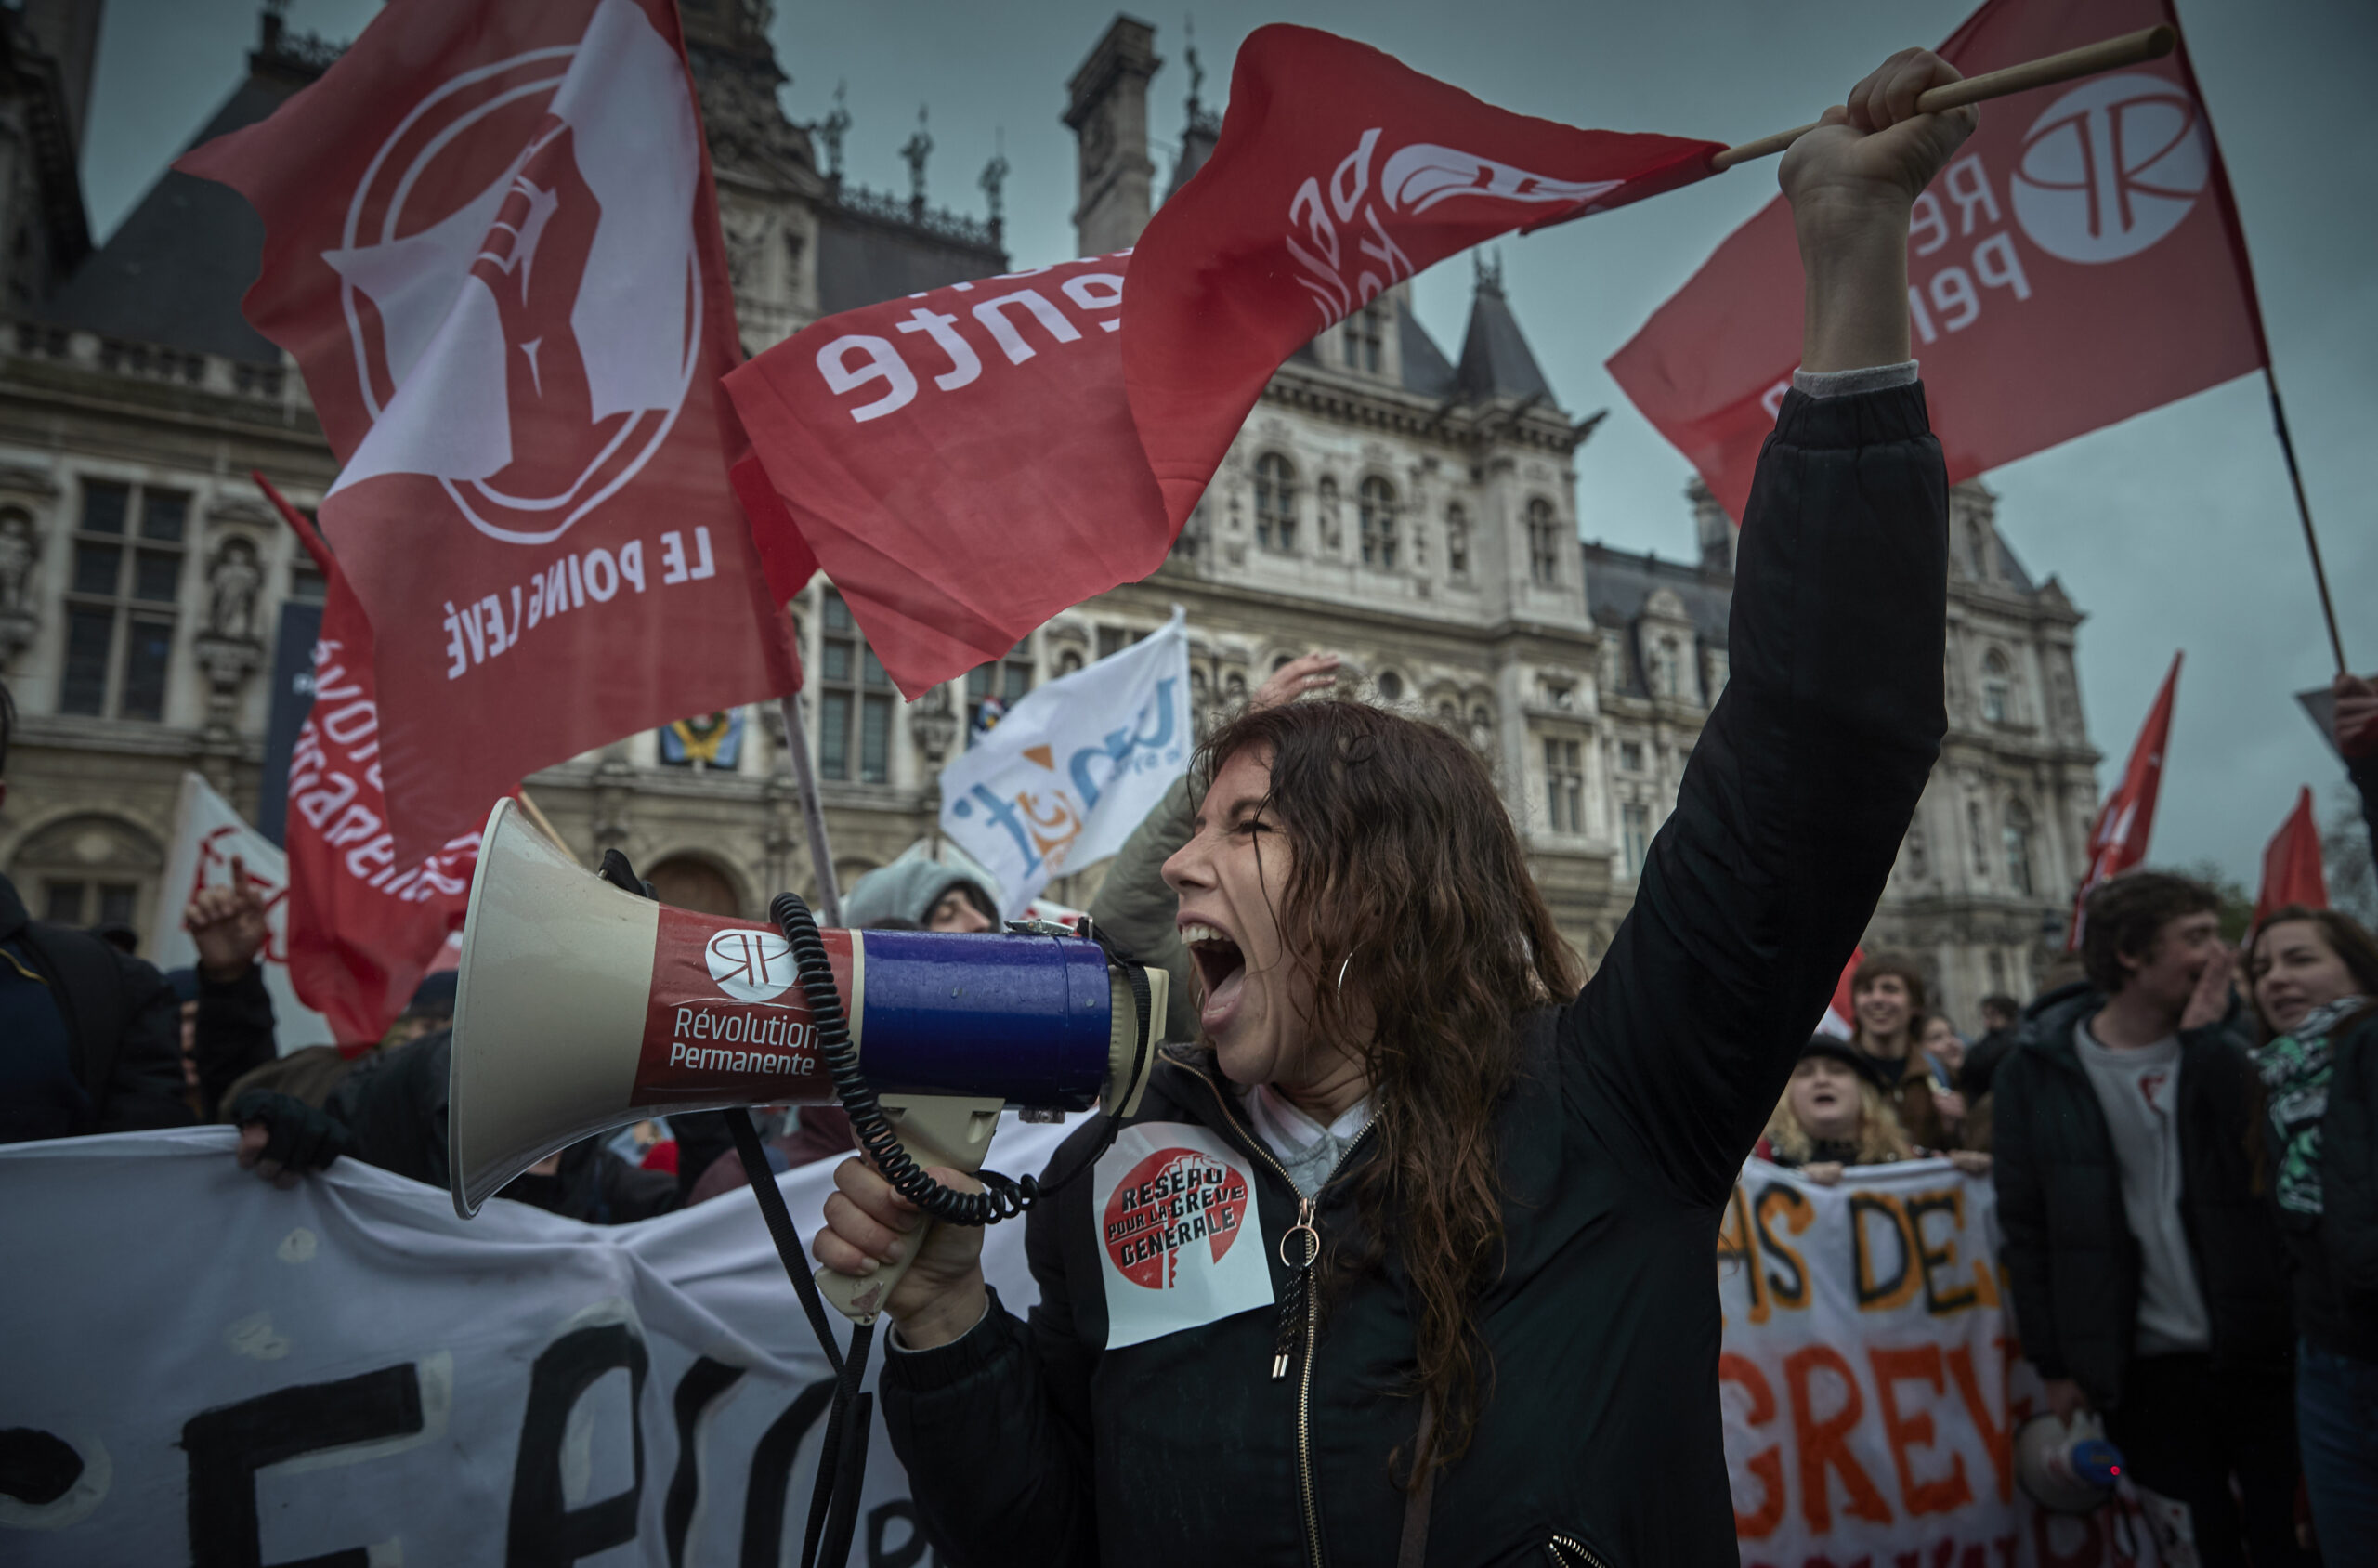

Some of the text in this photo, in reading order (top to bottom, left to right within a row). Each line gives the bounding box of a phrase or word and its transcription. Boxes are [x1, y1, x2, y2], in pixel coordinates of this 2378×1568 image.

[673, 1006, 819, 1050] Révolution
[669, 1042, 816, 1077] Permanente
[1107, 1185, 1246, 1239] POUR LA GREVE
[1121, 1168, 1223, 1213] RESEAU
[1120, 1205, 1235, 1269] GENERALE
[1847, 1186, 2001, 1319] DE
